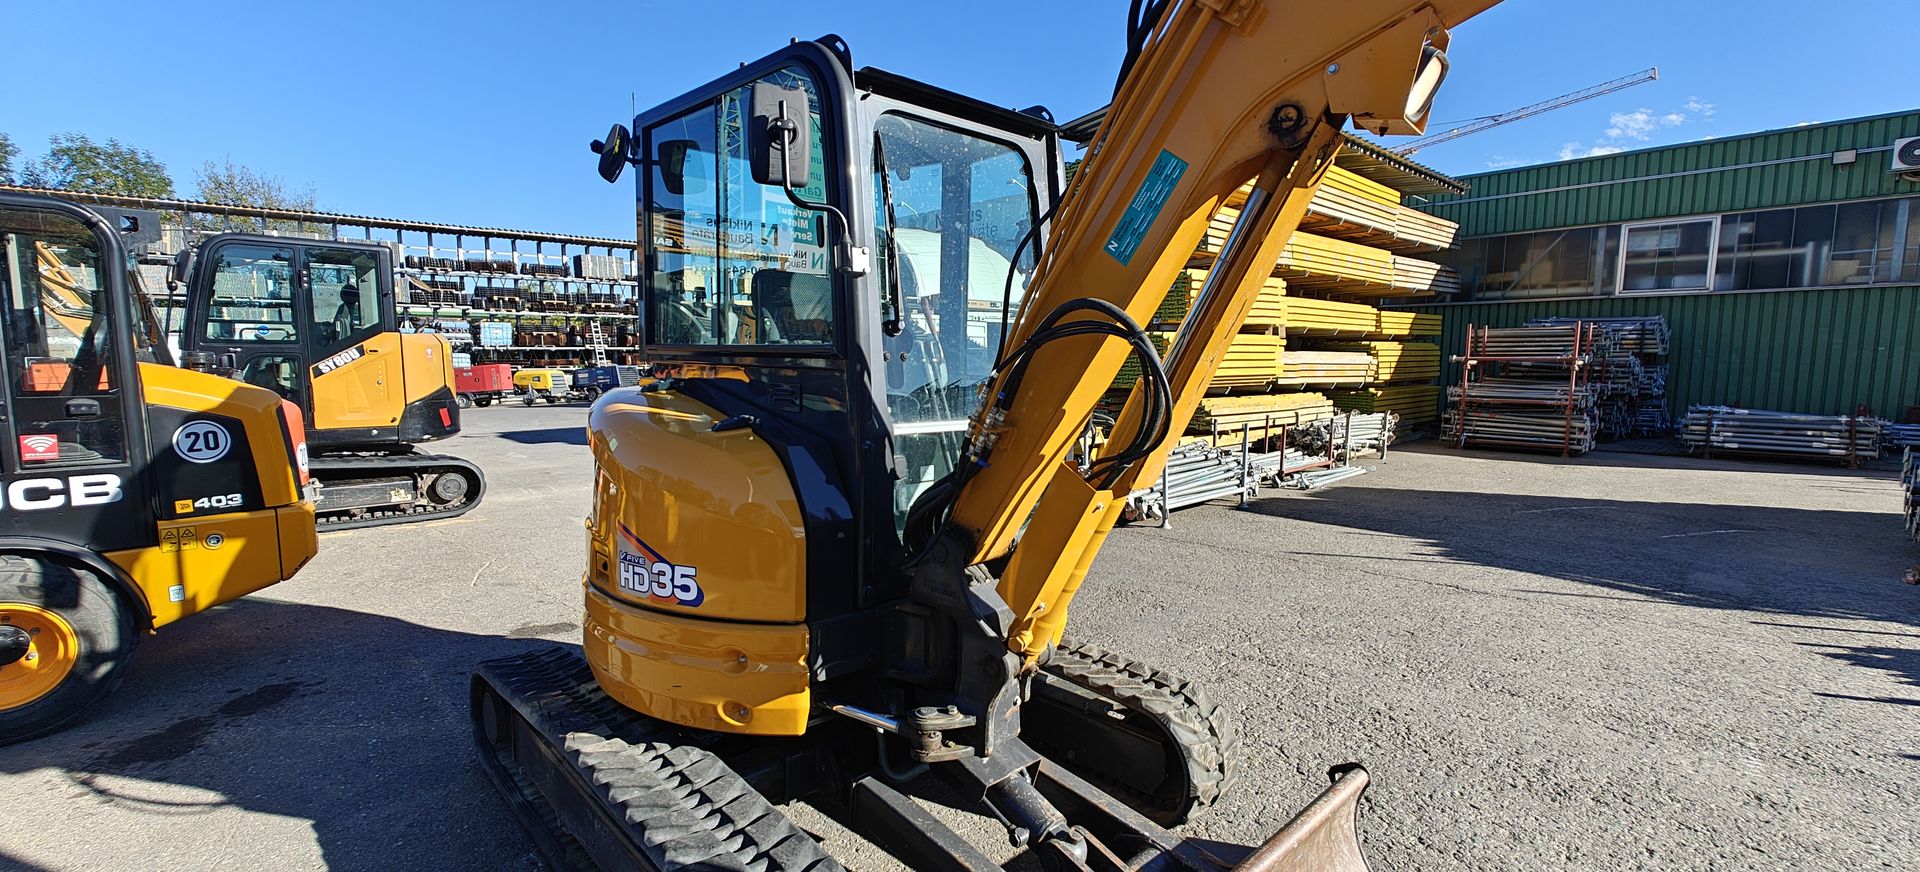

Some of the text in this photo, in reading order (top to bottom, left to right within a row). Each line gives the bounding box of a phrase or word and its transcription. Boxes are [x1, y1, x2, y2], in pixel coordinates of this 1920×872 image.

[318, 347, 361, 374] SY80U
[185, 430, 220, 453] 20
[0, 473, 123, 510] CB
[194, 493, 243, 509] 403
